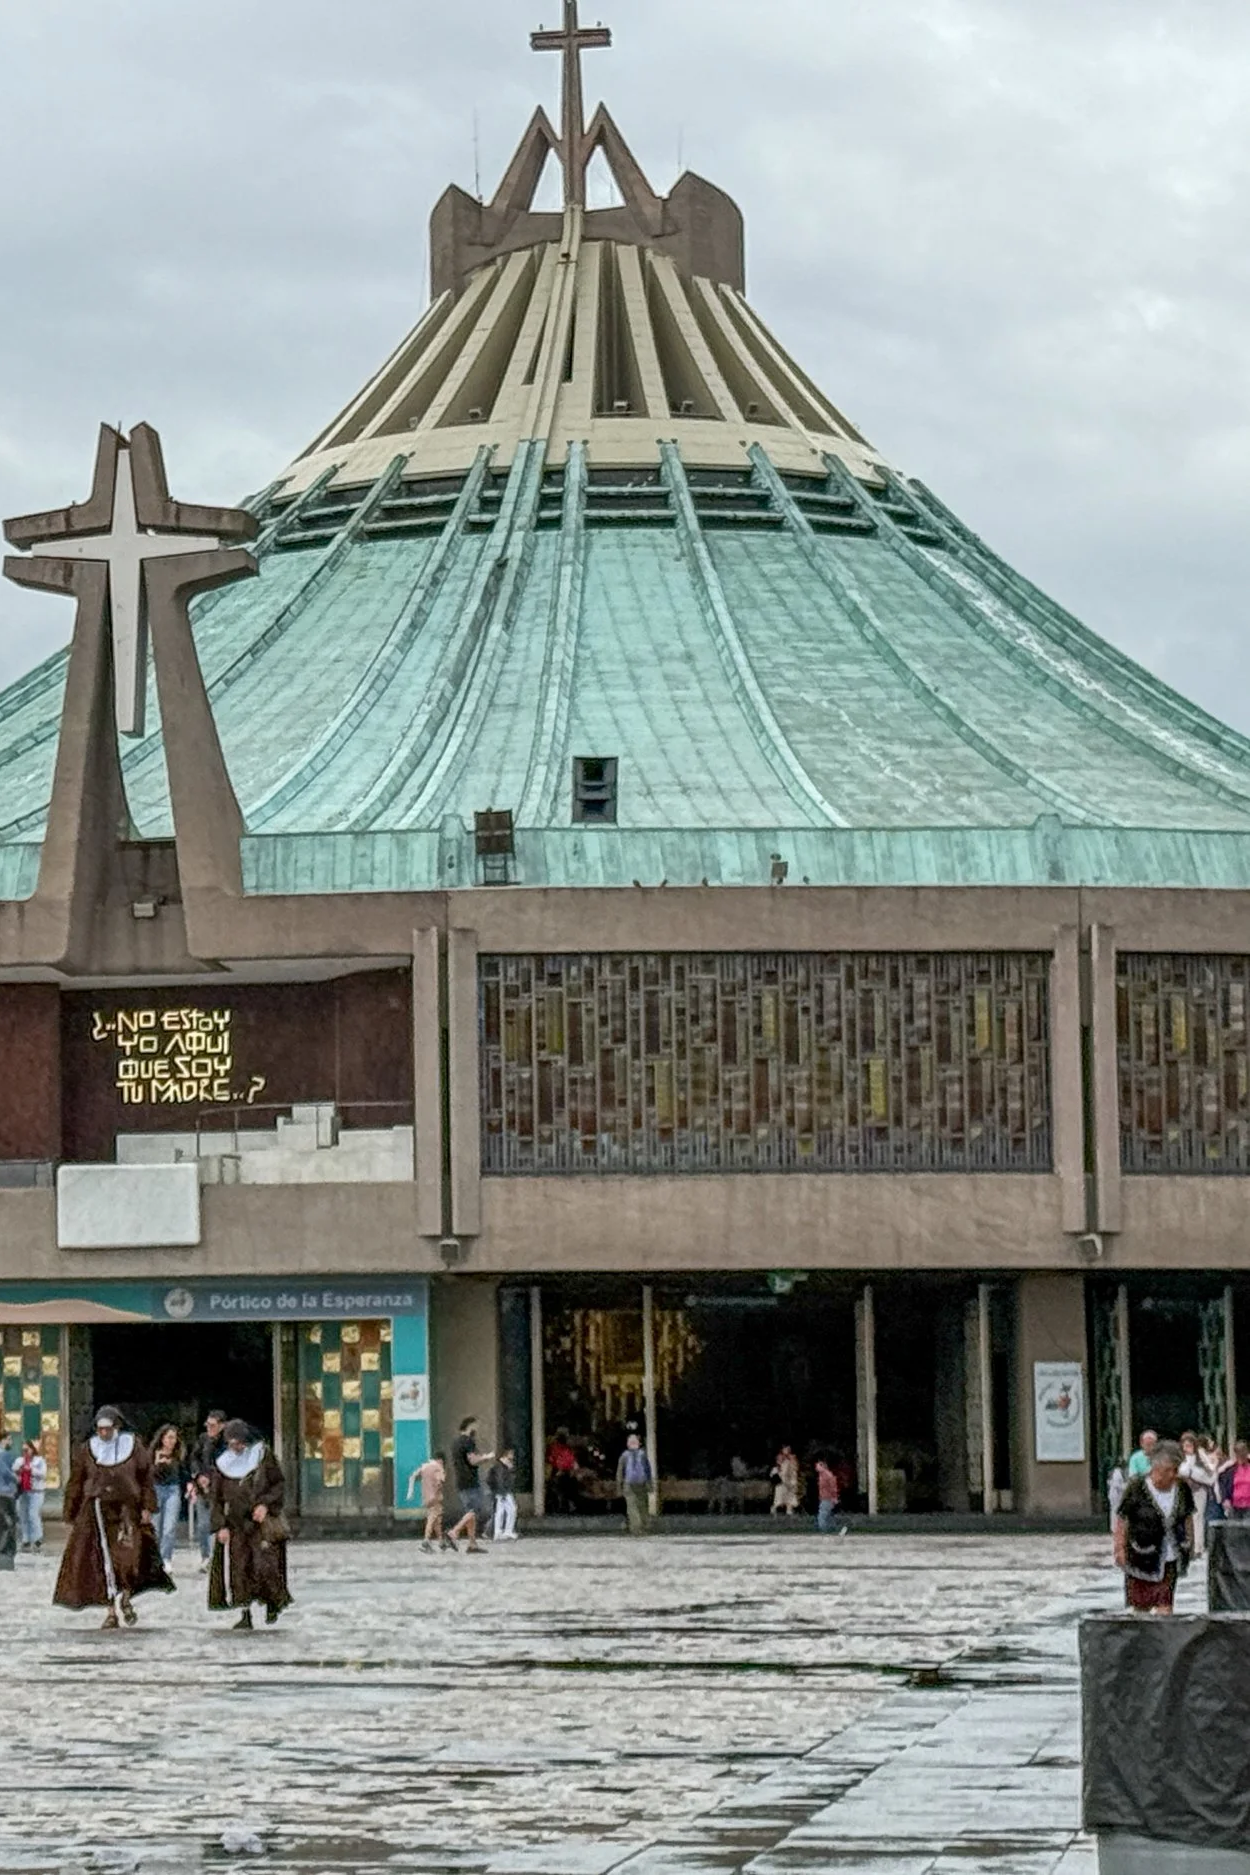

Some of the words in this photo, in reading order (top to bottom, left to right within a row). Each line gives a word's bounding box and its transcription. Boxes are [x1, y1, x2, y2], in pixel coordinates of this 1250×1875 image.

[117, 1034, 158, 1056] YO
[118, 1058, 171, 1079] QUE
[174, 1056, 232, 1078] SOY
[116, 1081, 143, 1104] TU
[209, 1294, 271, 1310] Pórtico
[276, 1292, 297, 1309] de
[301, 1292, 318, 1308] la
[322, 1291, 414, 1311] Esperanza
